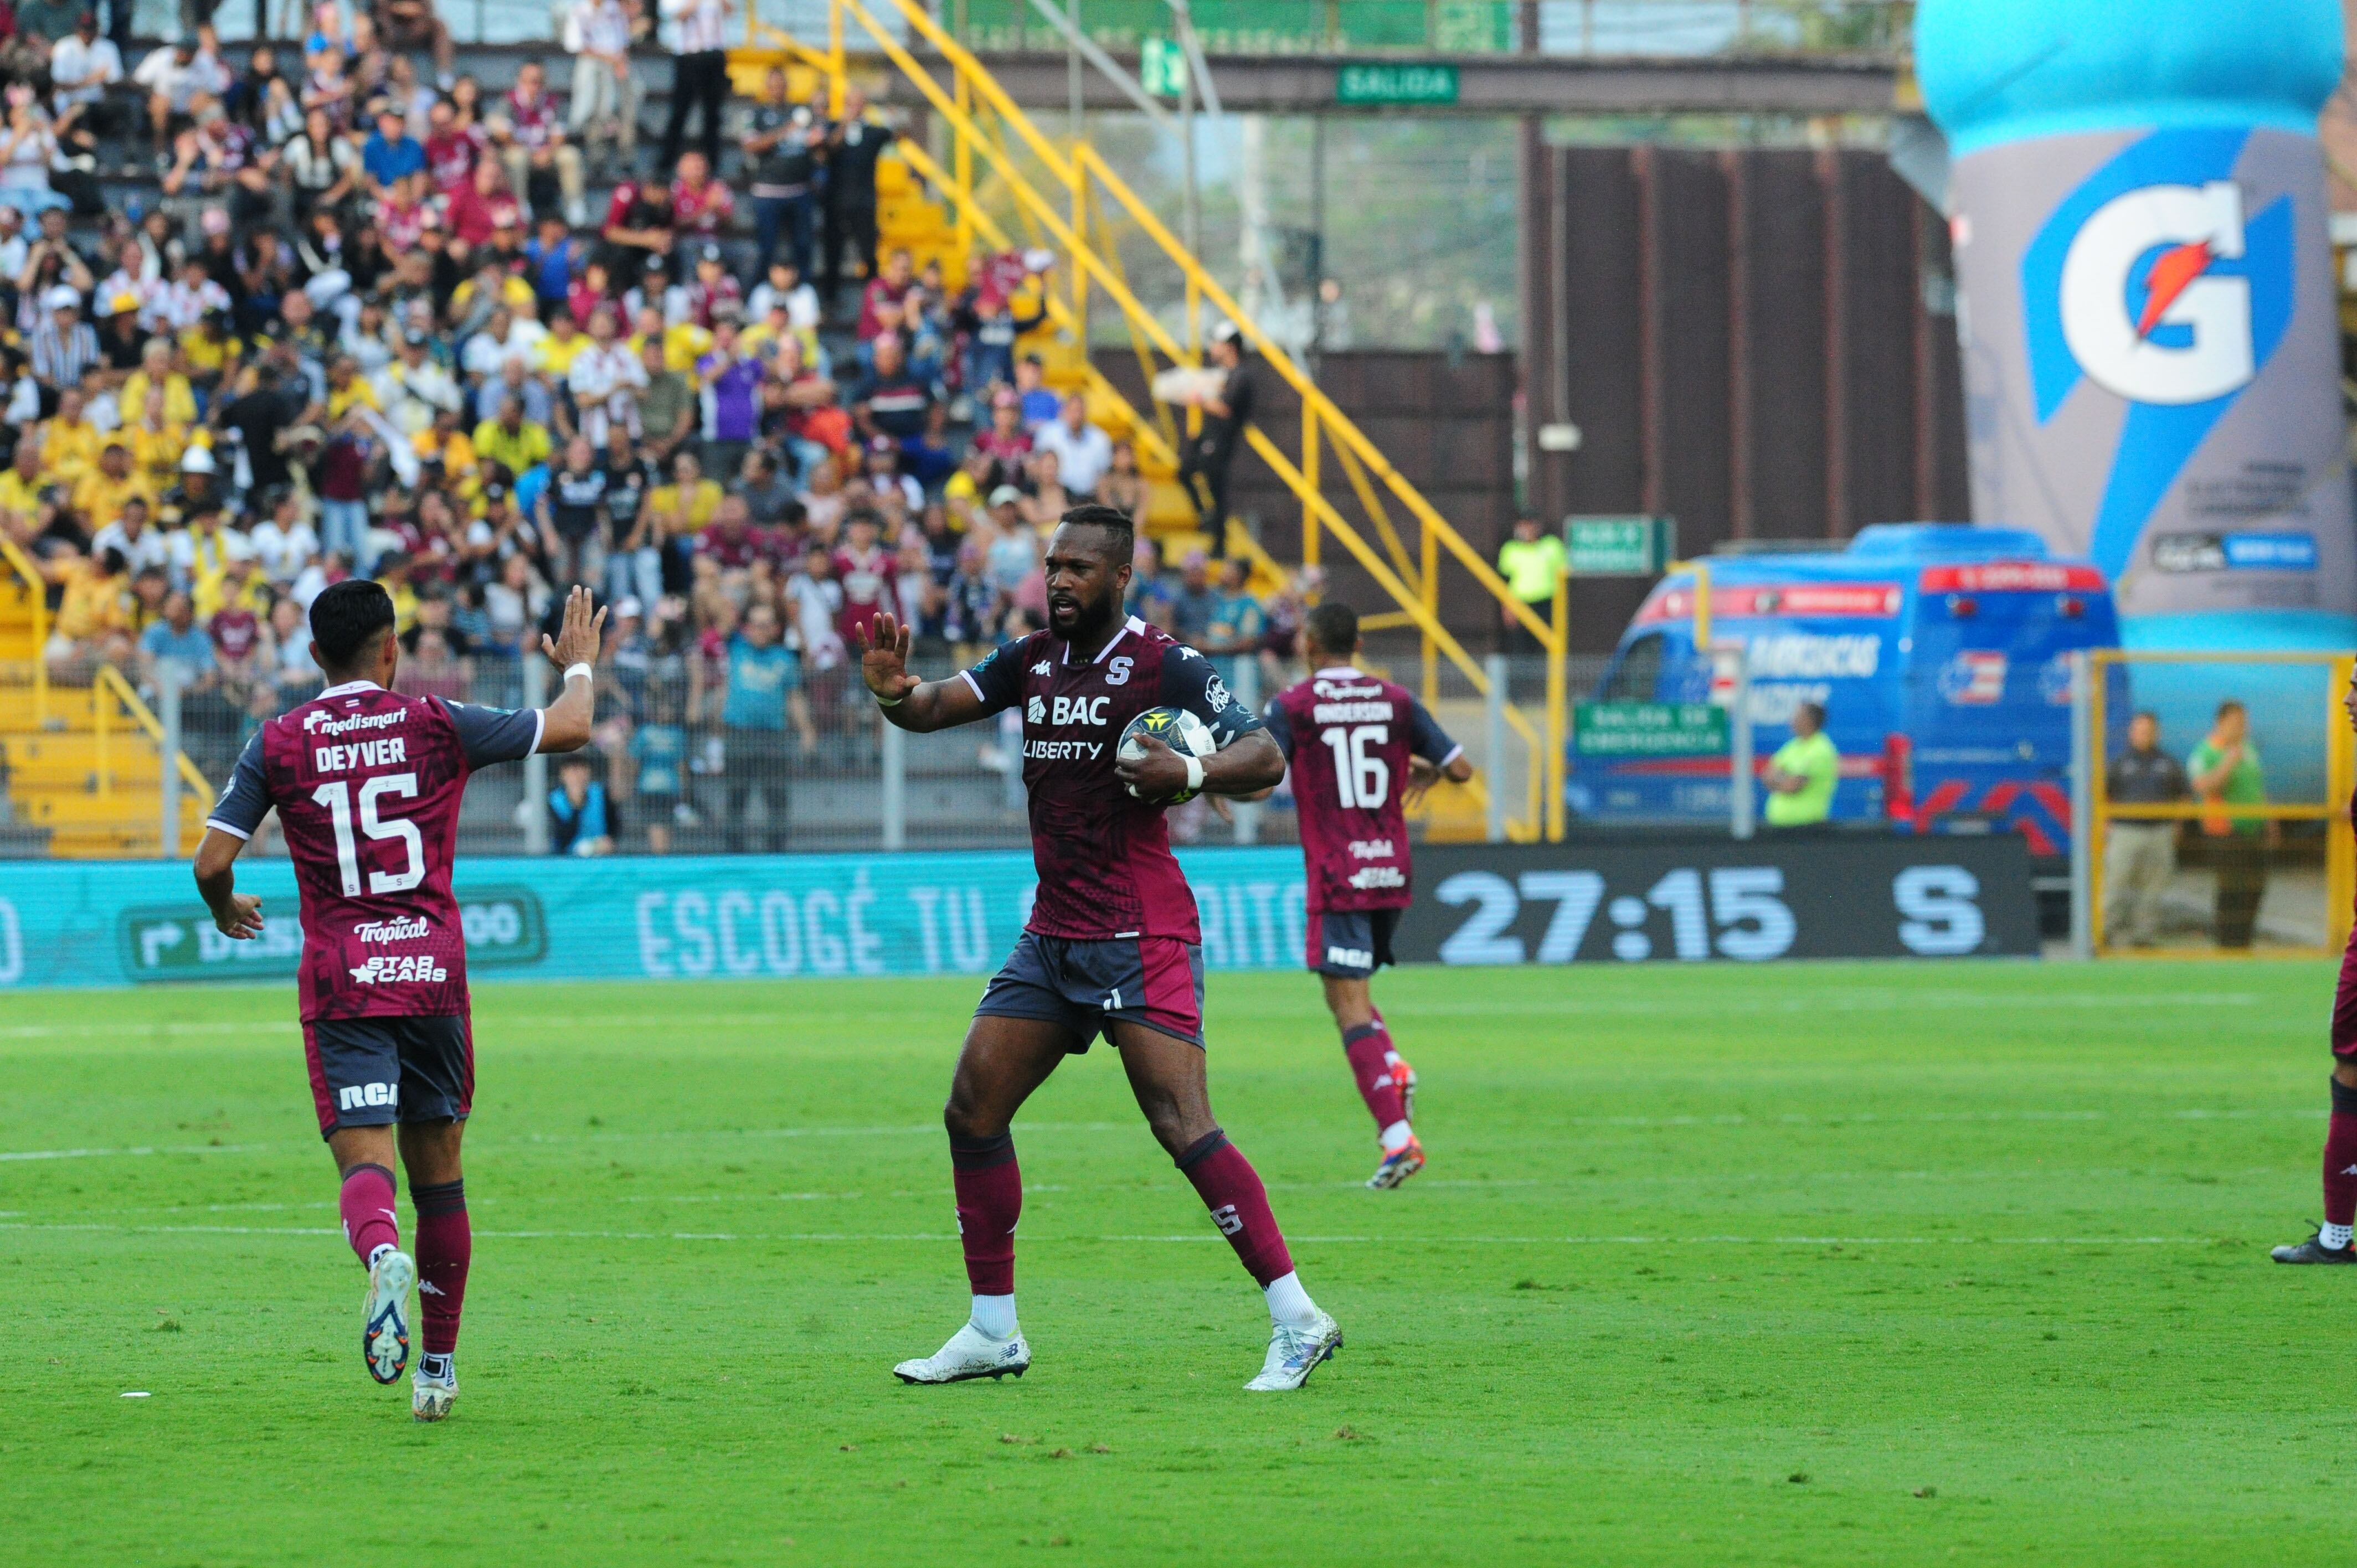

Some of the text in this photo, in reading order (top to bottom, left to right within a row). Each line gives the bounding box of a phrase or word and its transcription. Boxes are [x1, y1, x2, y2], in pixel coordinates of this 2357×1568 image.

[1344, 66, 1452, 100] SALIDA
[2060, 180, 2256, 405] G
[1105, 656, 1134, 685] S
[321, 707, 408, 736] medismart
[1052, 696, 1110, 726] BAC
[1591, 706, 1672, 727] SALIDA
[316, 737, 406, 773] DEYVER
[1022, 741, 1104, 760] LIBERTY
[1320, 724, 1390, 809] 16
[311, 772, 426, 898] 15
[637, 868, 886, 977] ESCOGÉ
[909, 886, 990, 973] TU
[1435, 866, 1798, 965] 27:15
[1892, 864, 1986, 956] S
[354, 915, 430, 946] Tropical
[367, 956, 435, 972] STAR
[377, 968, 447, 983] CARS
[1211, 1204, 1243, 1236] S
